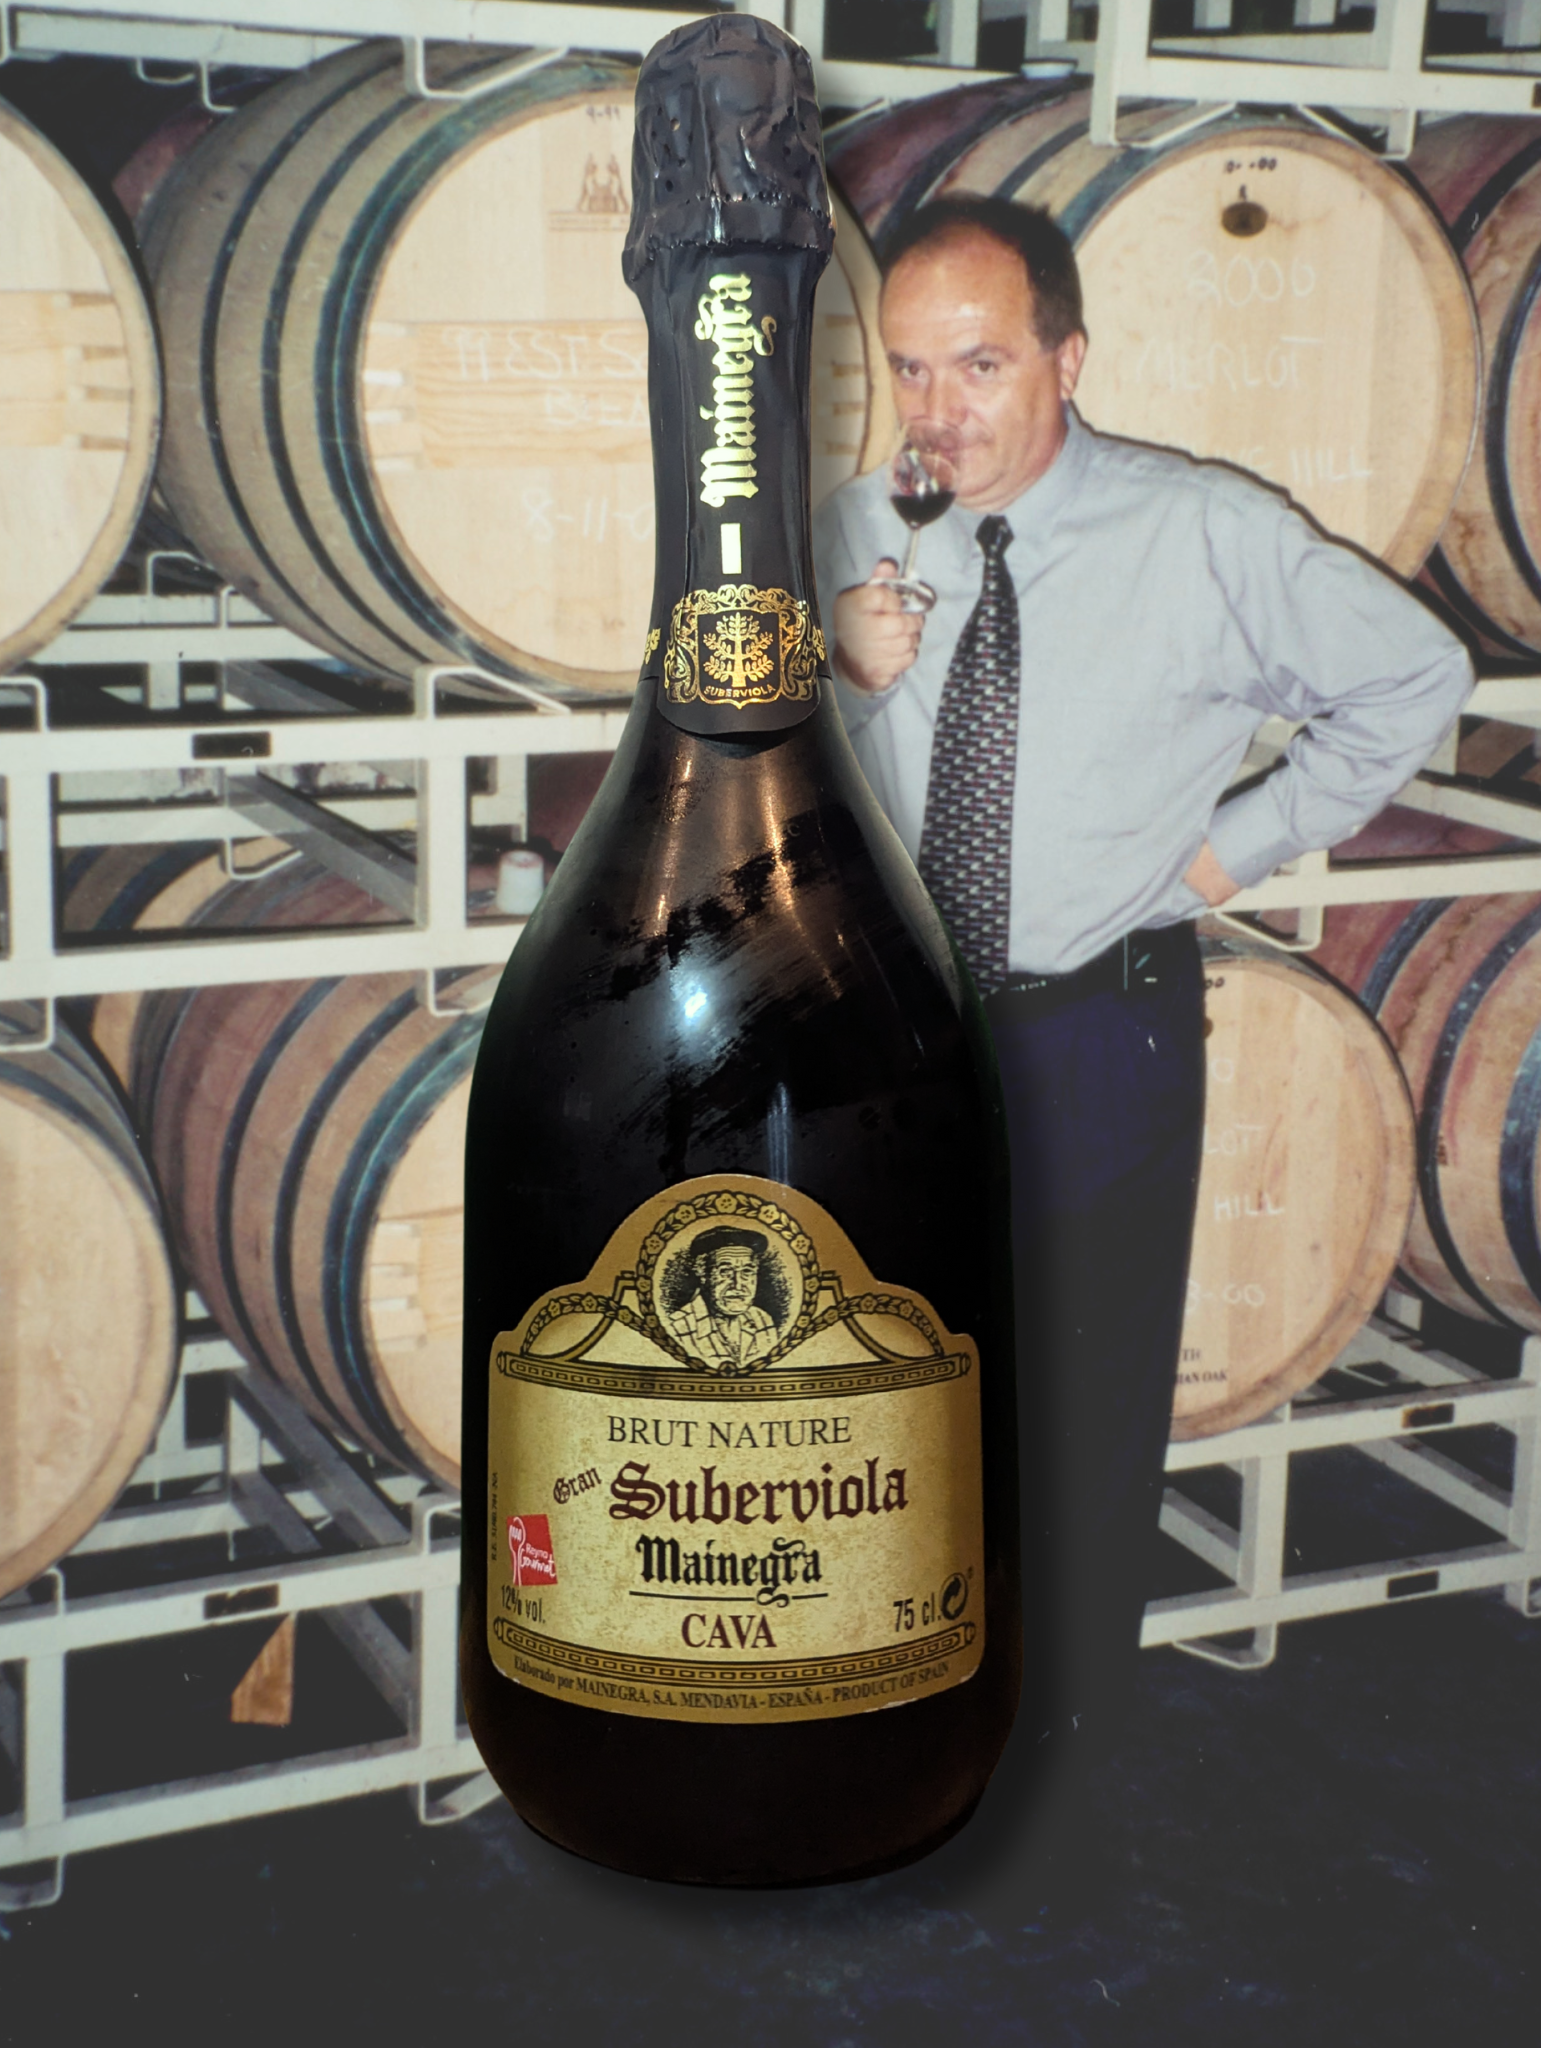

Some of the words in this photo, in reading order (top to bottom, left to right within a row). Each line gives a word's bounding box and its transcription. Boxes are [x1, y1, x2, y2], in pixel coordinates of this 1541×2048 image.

[704, 683, 776, 698] SUBERVIOLA
[1213, 1191, 1286, 1222] HILL
[607, 1416, 697, 1447] BRUT
[708, 1416, 853, 1449] NATURE
[552, 1466, 603, 1505] Gran
[608, 1456, 909, 1526] Suberviola
[635, 1534, 823, 1609] Mainegra
[501, 1584, 523, 1616] 12%
[525, 1597, 546, 1625] vol.
[893, 1597, 914, 1632] 75
[922, 1591, 942, 1627] cl.
[681, 1613, 777, 1650] CAVA
[513, 1655, 556, 1685] Elaborado
[557, 1673, 575, 1690] por
[900, 1673, 915, 1688] OF
[918, 1660, 950, 1684] SPAIN
